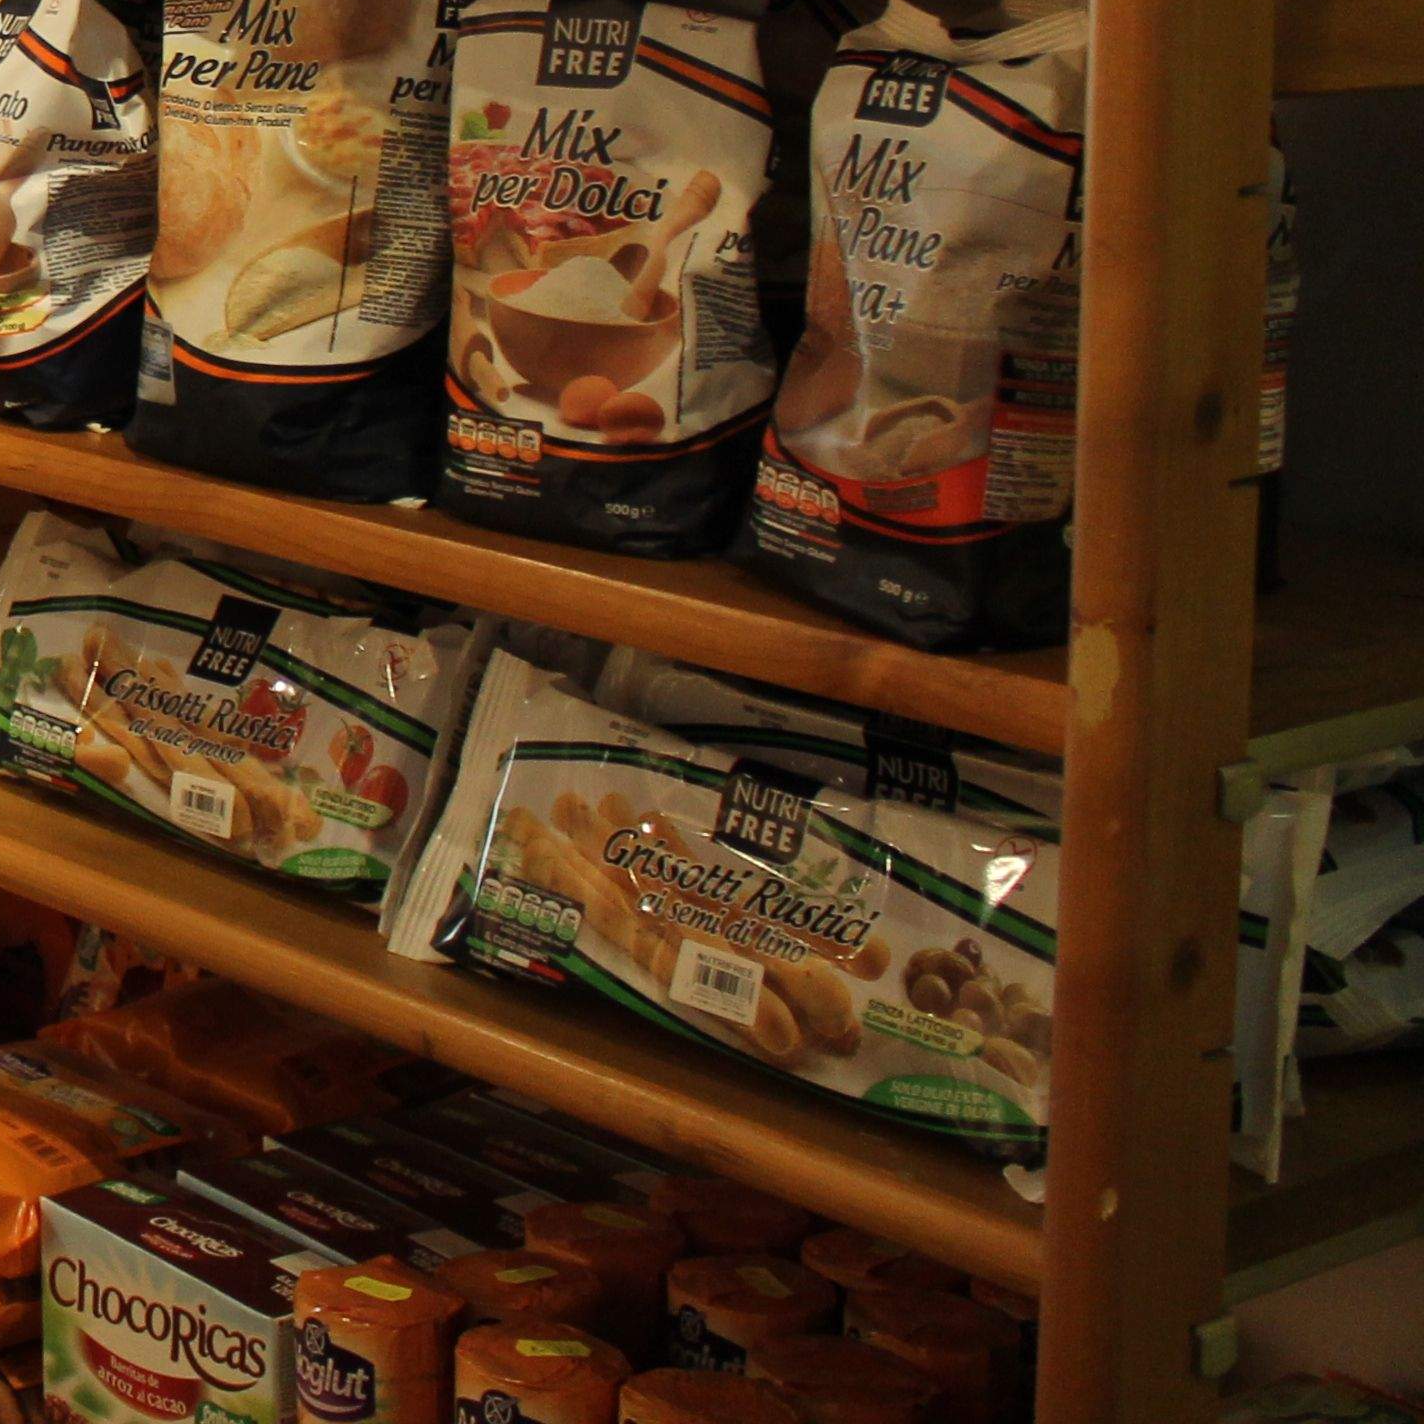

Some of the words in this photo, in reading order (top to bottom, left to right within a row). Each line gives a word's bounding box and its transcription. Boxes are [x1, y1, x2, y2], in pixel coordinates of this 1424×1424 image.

[553, 22, 630, 49] NUTRI
[161, 50, 238, 91] per
[236, 49, 320, 93] Pane
[549, 47, 625, 78] FREE
[244, 102, 273, 114] Senza
[389, 75, 440, 105] per
[866, 82, 936, 115] FREE
[256, 116, 291, 128] Product
[520, 105, 622, 166] Mix
[832, 132, 928, 205] Mix
[470, 169, 533, 213] per
[542, 170, 669, 223] Dolci
[854, 205, 945, 269] Pane
[210, 626, 262, 655] NUTRI
[196, 648, 250, 678] FREE
[104, 668, 213, 724] Grissotti
[877, 754, 950, 792] NUTRI
[733, 779, 804, 824] NUTRI
[723, 810, 797, 854] FREE
[603, 828, 752, 907] Grissotti
[745, 877, 881, 949] Rustici
[639, 889, 666, 916] ai
[669, 900, 726, 934] semi
[724, 911, 754, 945] di
[756, 924, 810, 964] lino
[48, 1255, 267, 1393] ChocoRicas
[97, 1366, 136, 1399] arroz
[149, 1390, 188, 1417] cacao
